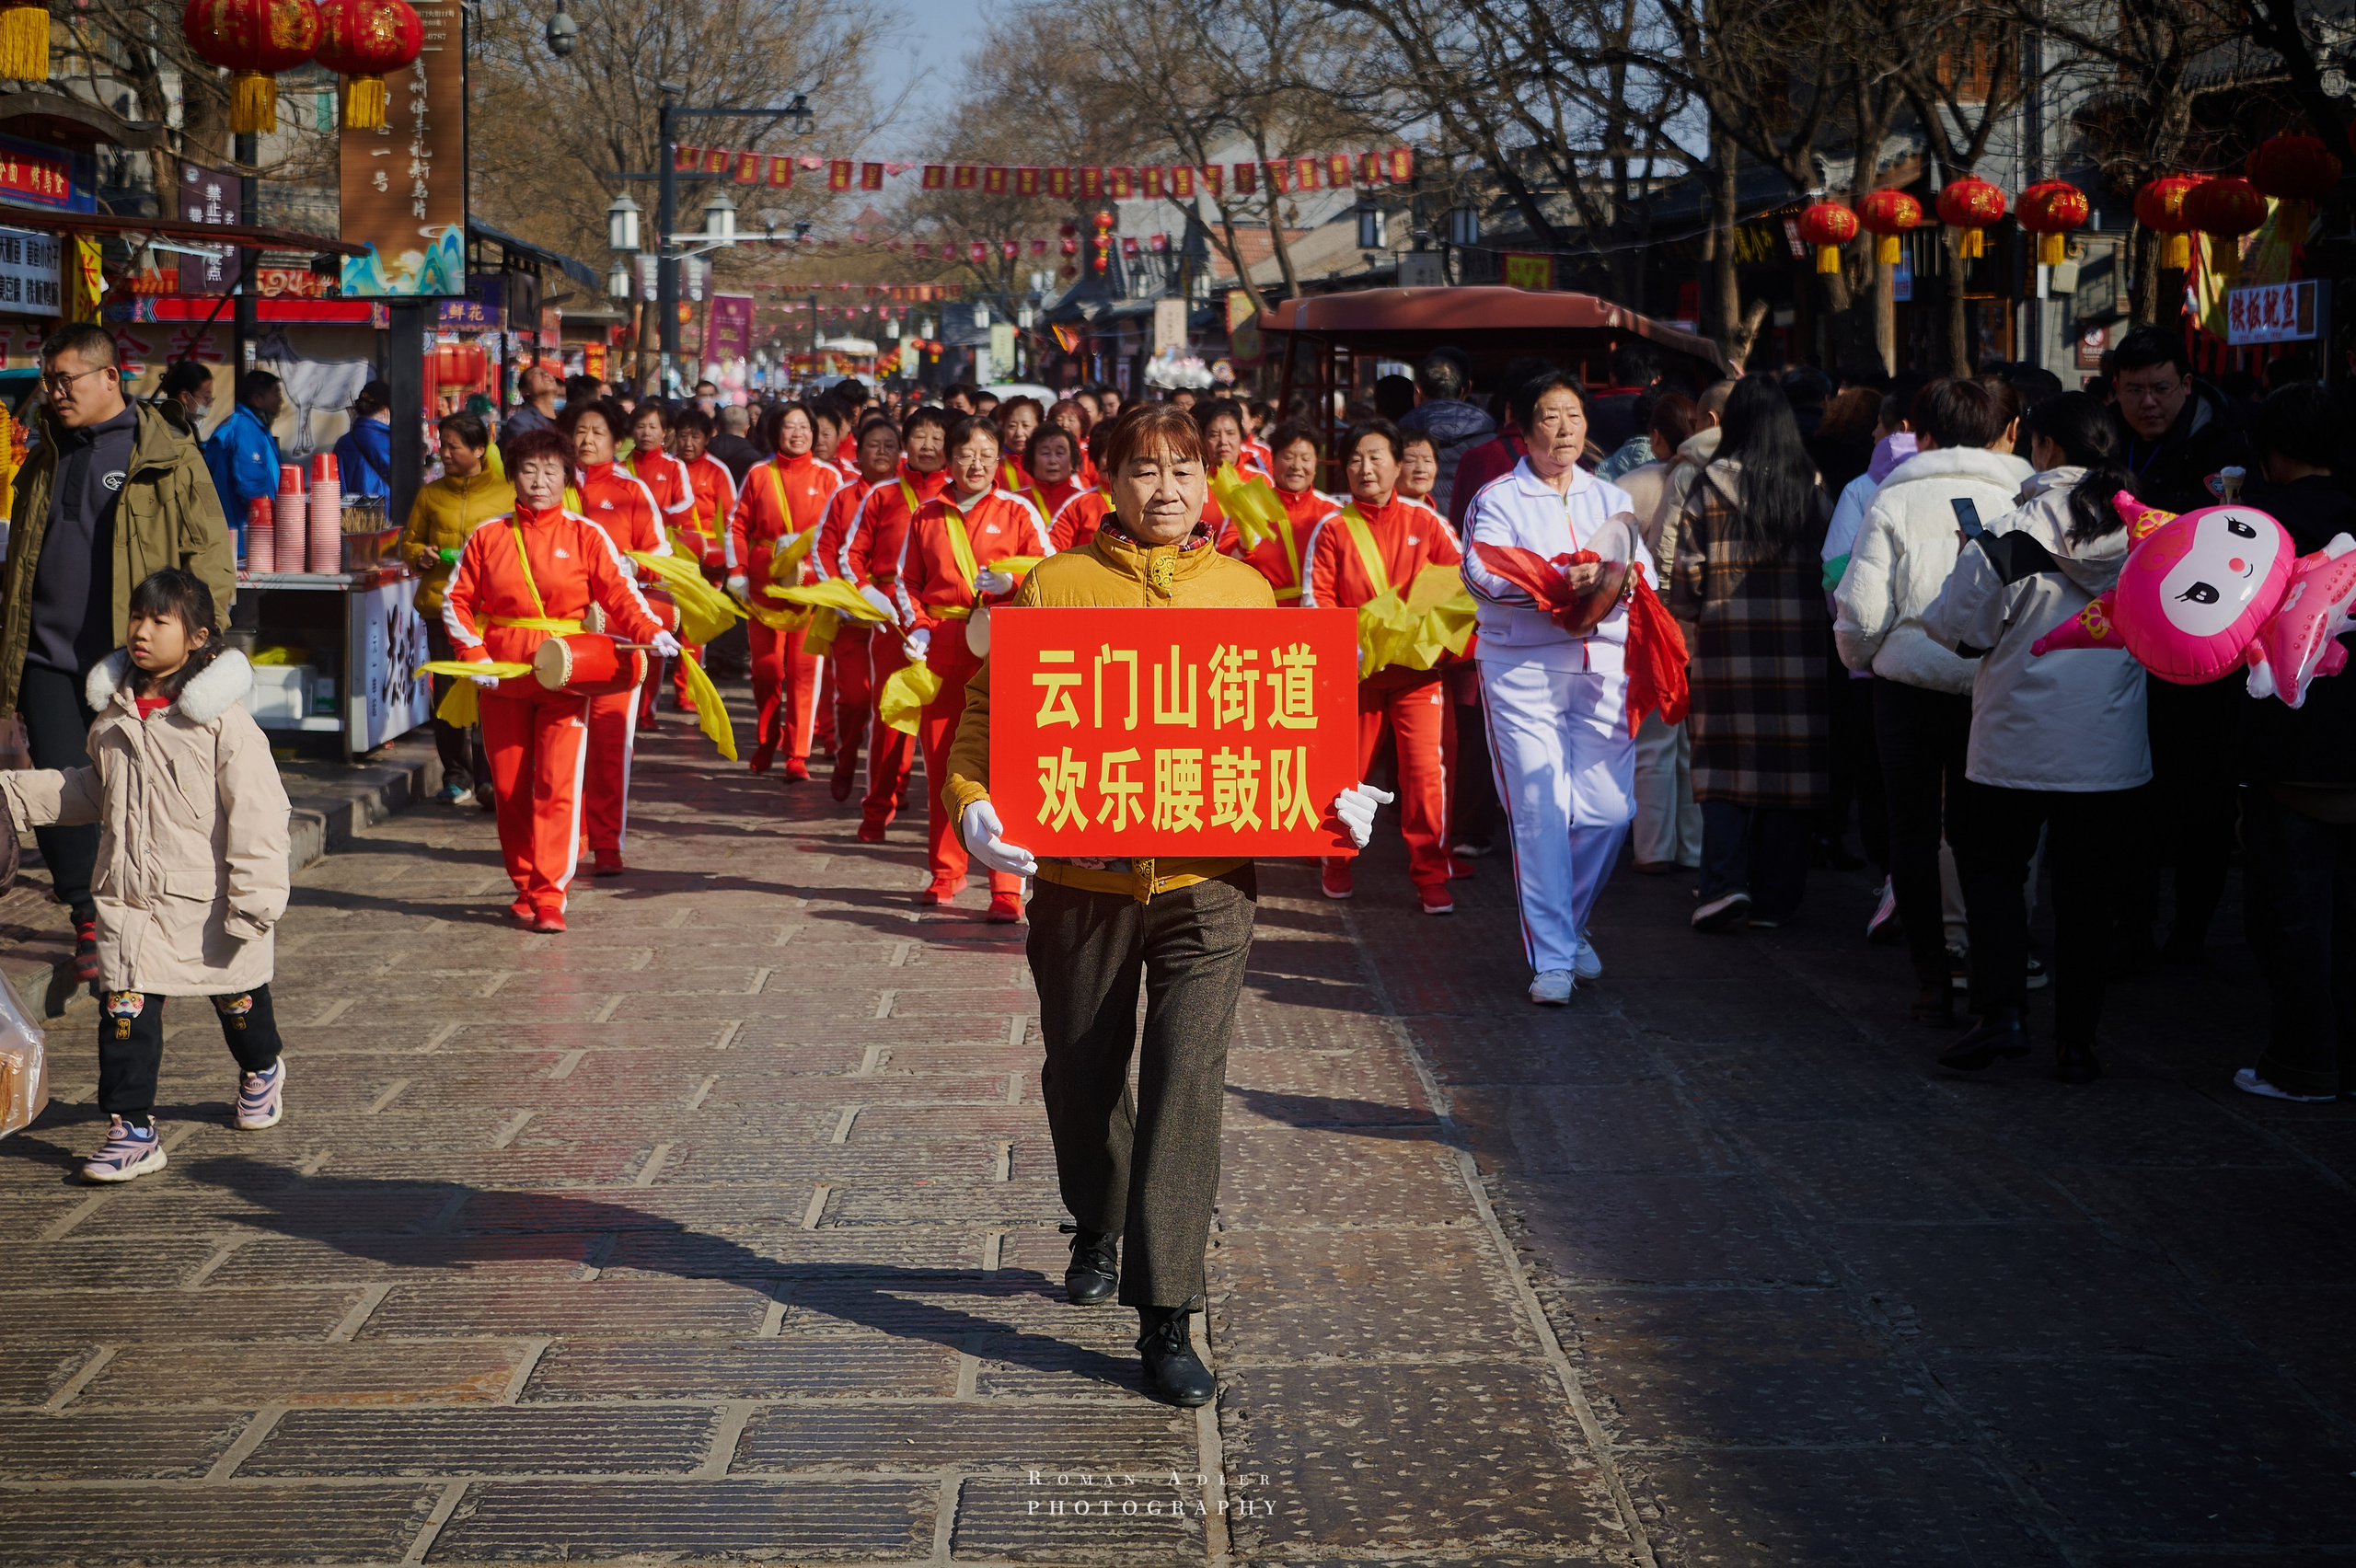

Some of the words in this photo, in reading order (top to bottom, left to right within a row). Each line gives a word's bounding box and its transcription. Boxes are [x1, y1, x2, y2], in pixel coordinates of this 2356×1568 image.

[407, 57, 433, 220] 青州伴手礼新名片
[2229, 283, 2295, 333] 铁板鱿鱼
[1033, 642, 1319, 731] 云门山街道
[1036, 745, 1321, 834] 欢乐腰鼓队
